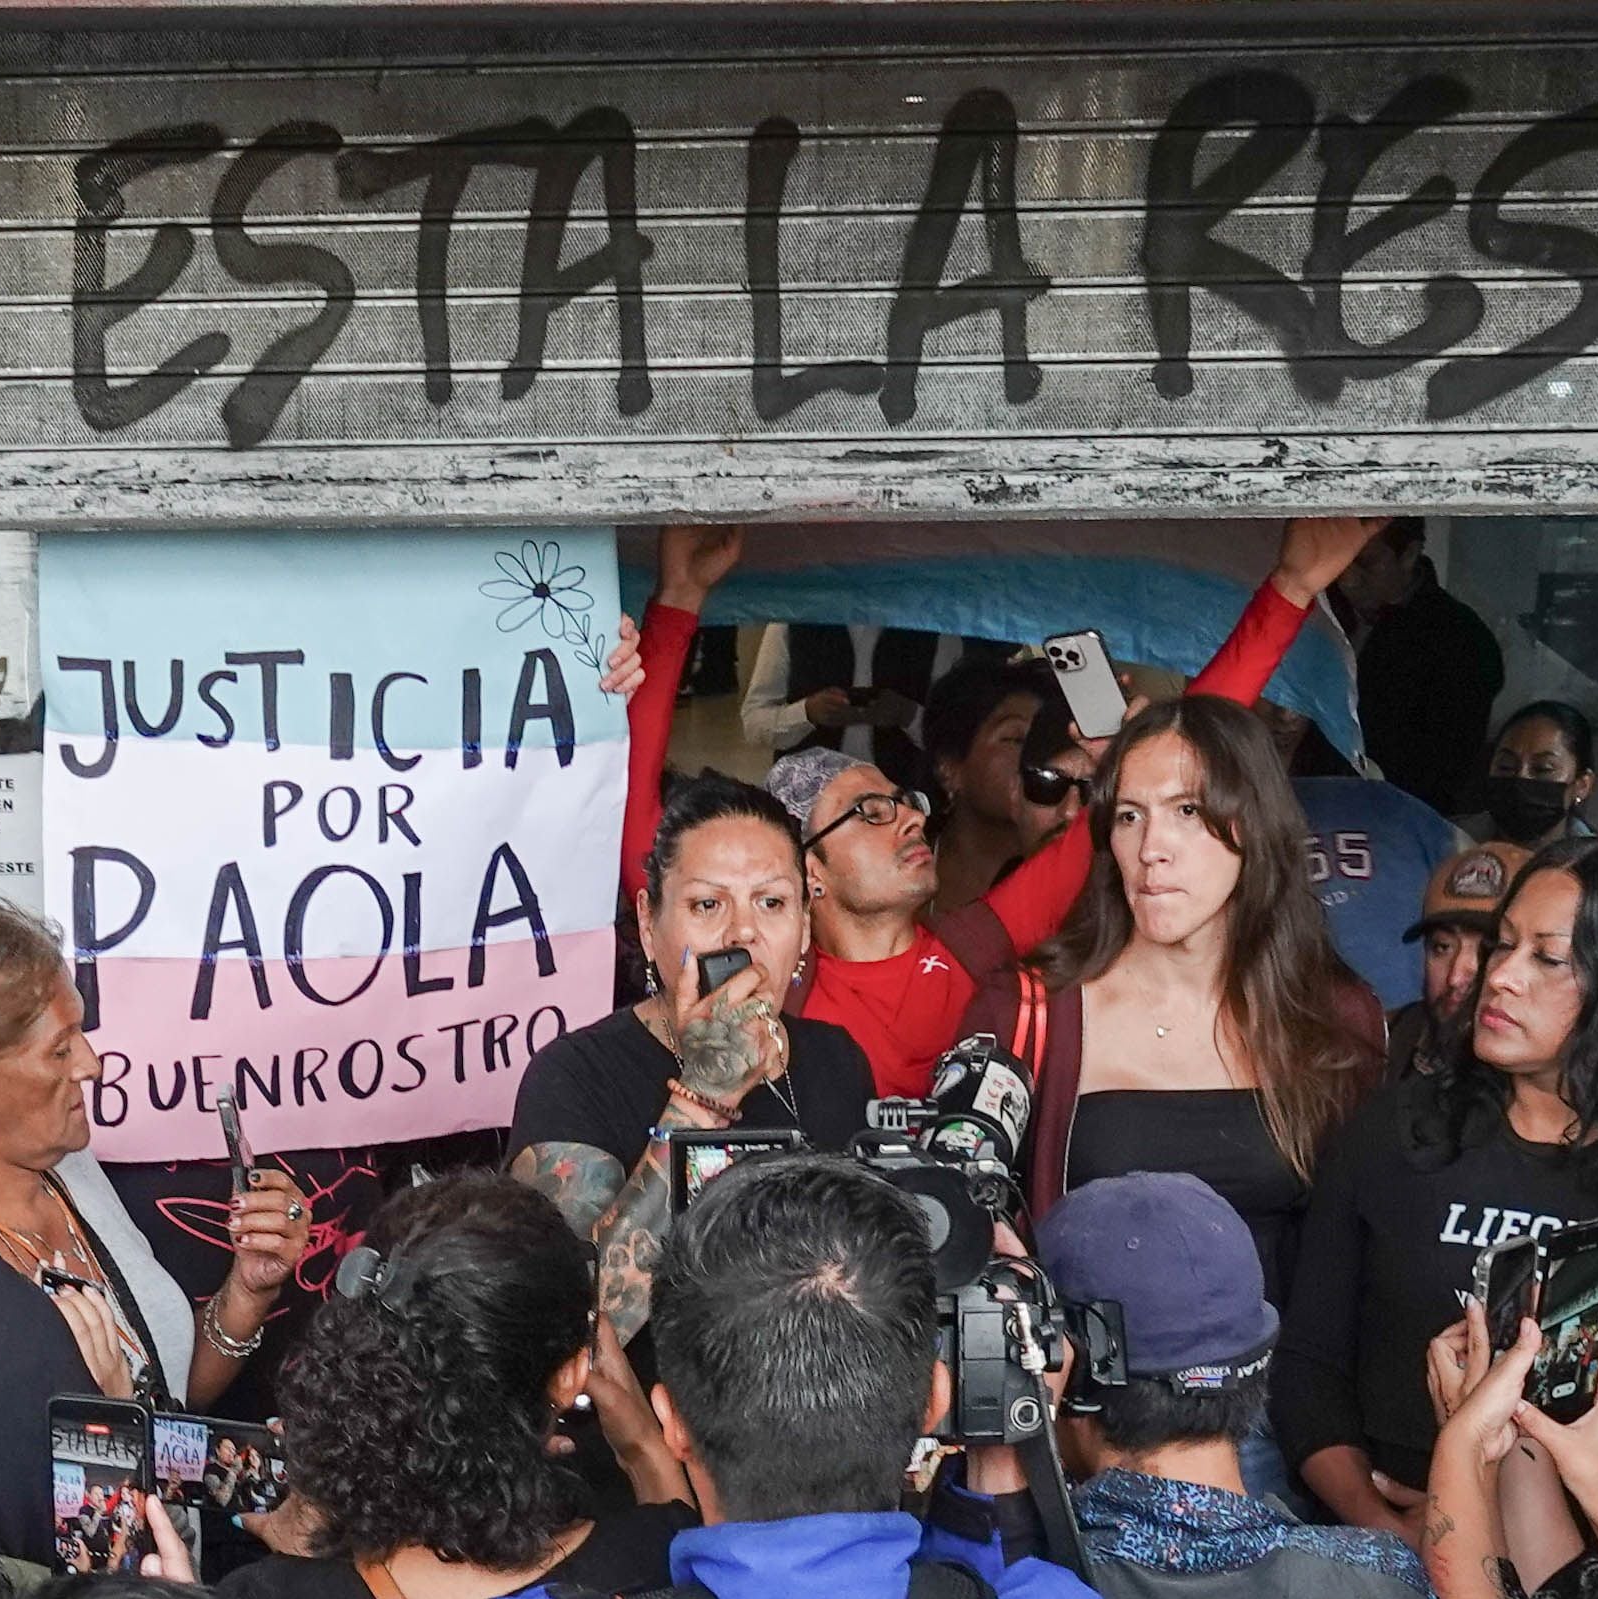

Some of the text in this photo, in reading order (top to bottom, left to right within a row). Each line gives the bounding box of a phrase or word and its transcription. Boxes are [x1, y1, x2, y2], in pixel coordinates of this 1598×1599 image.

[71, 104, 655, 450] ESTA
[747, 87, 1052, 427] LA
[56, 648, 576, 779] JUSTICIA
[262, 780, 421, 848] POR
[70, 841, 557, 1032] PAOLA
[93, 1005, 567, 1128] BUENROSTRO
